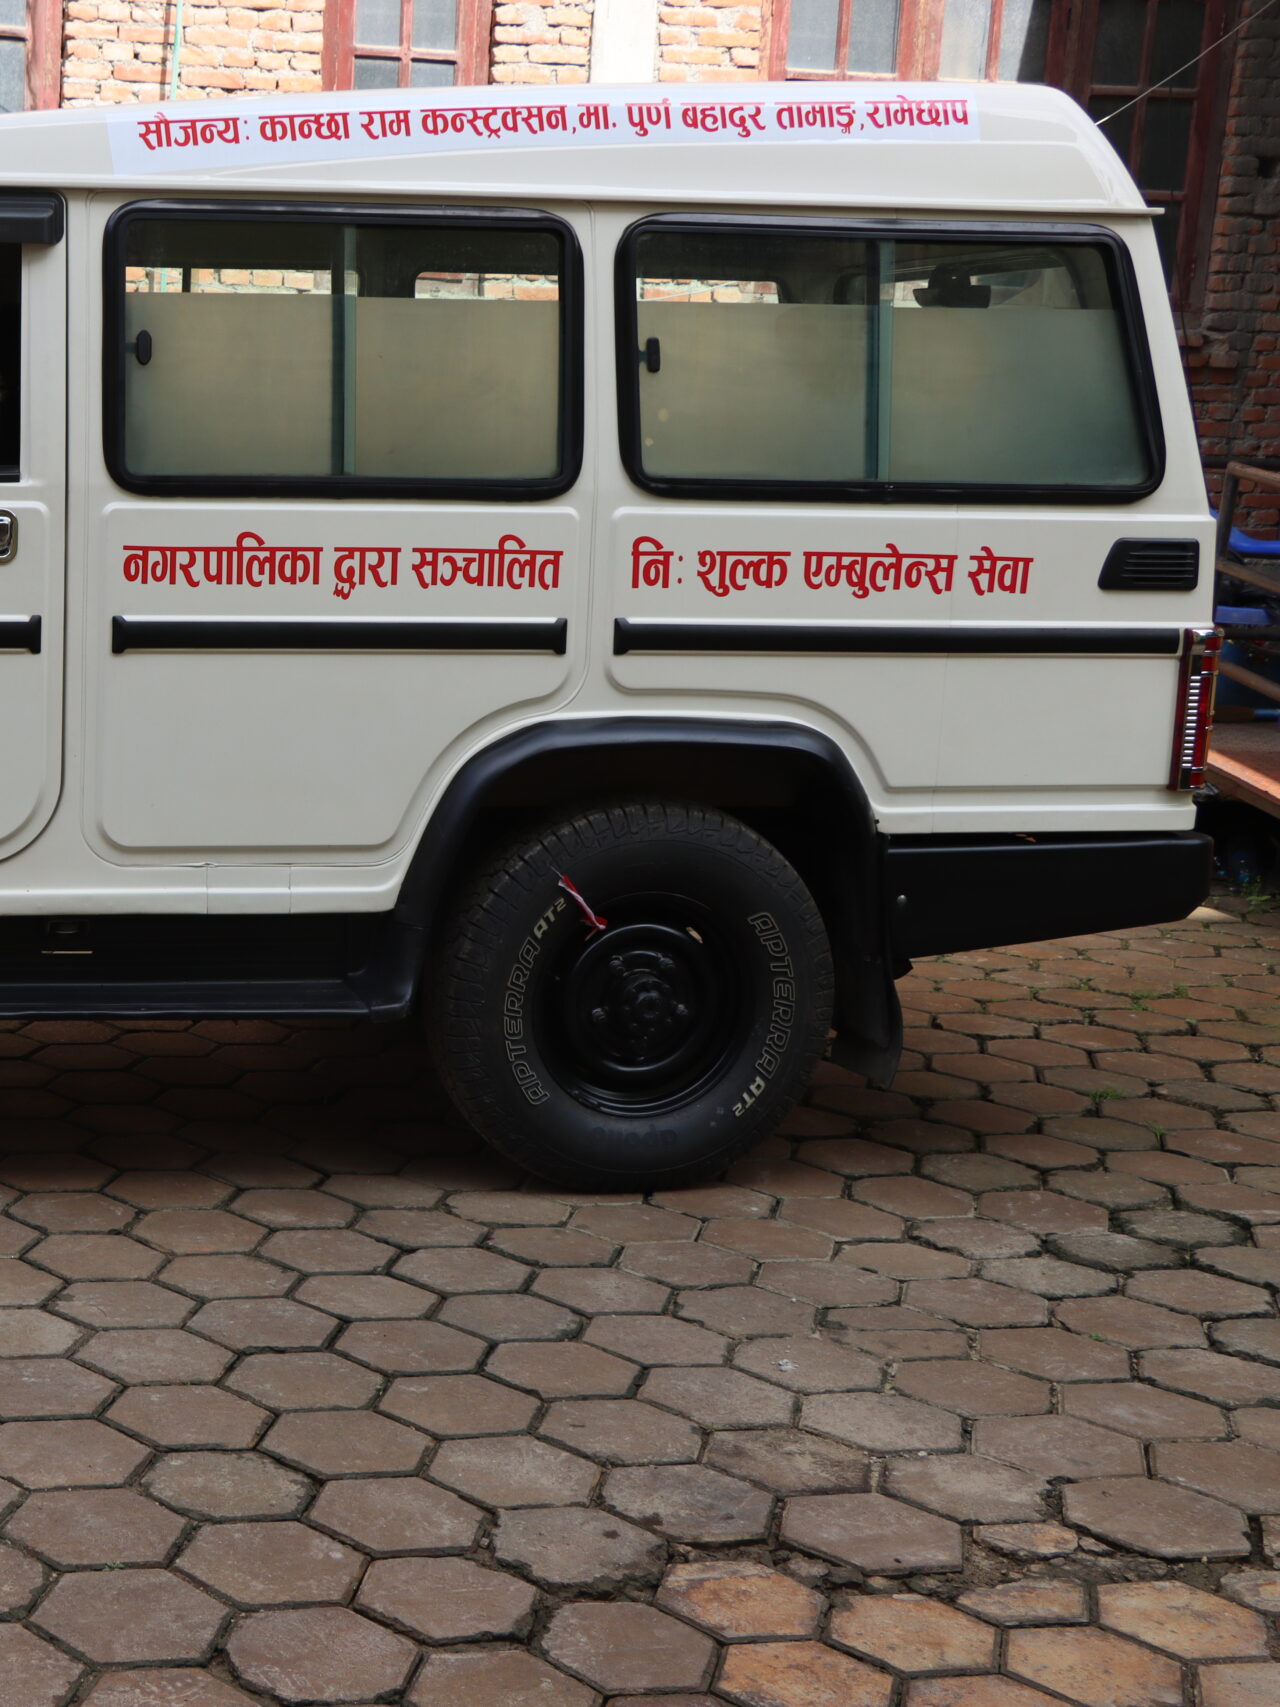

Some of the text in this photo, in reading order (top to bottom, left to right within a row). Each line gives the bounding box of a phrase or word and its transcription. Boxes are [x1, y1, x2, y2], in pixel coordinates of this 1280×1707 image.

[258, 111, 350, 142] कान्छा
[360, 109, 411, 139] राम
[681, 101, 766, 138] बहादुर
[123, 531, 564, 600] नगरपालिका द्वारा सञ्चालित
[803, 543, 959, 599] एम्बुलेन्स
[968, 545, 1035, 597] सेवा
[504, 936, 550, 1105] APTERRA
[748, 912, 796, 1079] APTERRA
